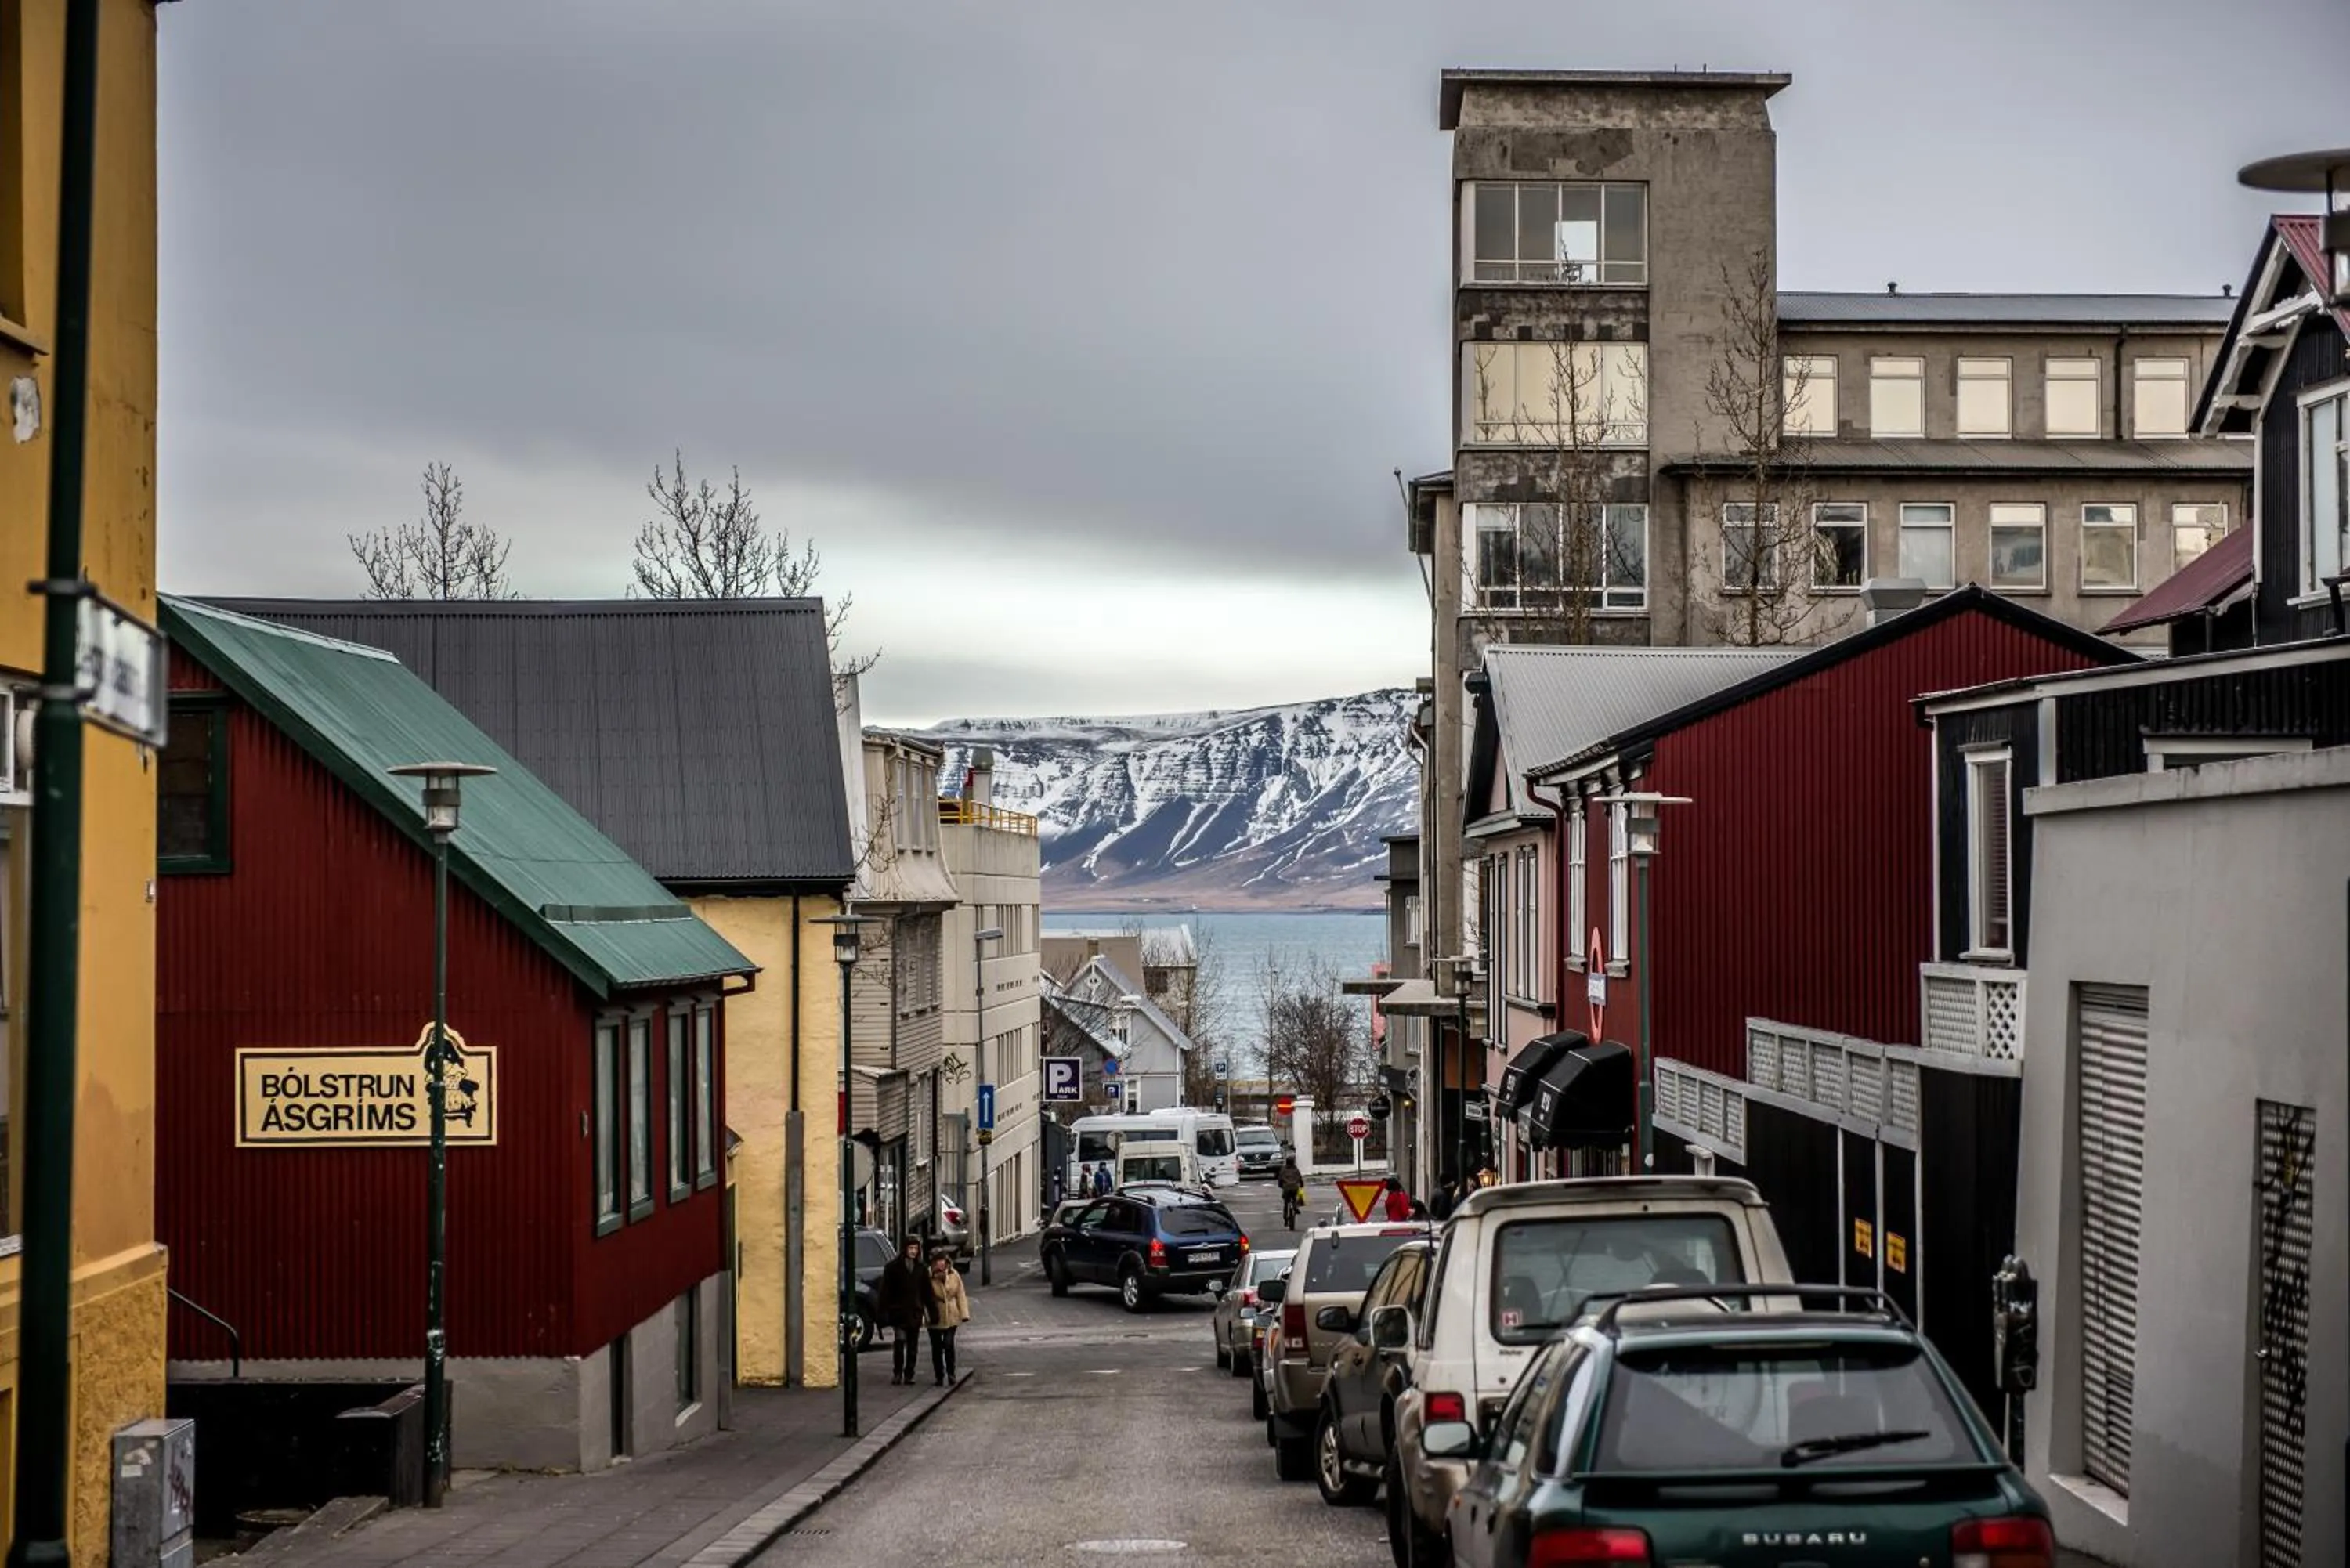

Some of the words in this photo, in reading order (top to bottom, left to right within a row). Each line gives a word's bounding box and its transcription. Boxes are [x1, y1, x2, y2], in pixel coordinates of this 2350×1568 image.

[261, 1067, 414, 1098] BÓLSTRUN
[261, 1098, 416, 1132] ÁSGRÍMS
[1350, 1124, 1367, 1133] STOP
[1742, 1532, 1867, 1545] SUBARU
